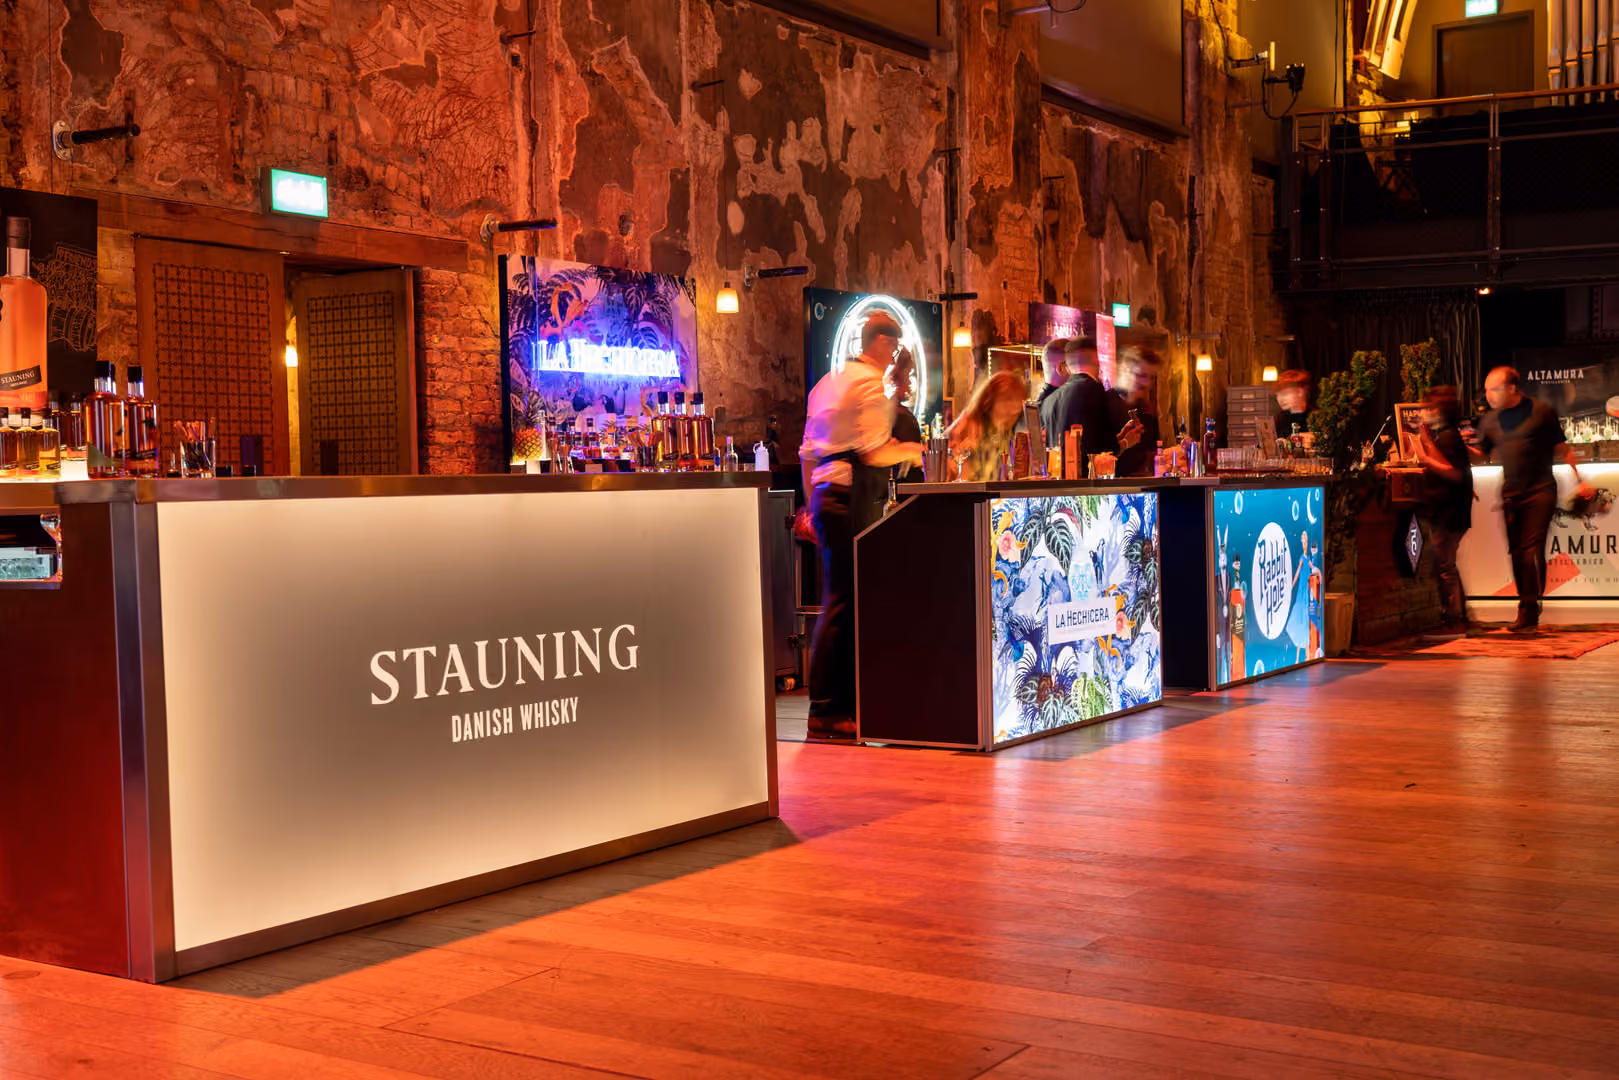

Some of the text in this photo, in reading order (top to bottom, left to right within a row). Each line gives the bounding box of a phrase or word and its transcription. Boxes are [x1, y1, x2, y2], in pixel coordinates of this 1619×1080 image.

[537, 340, 570, 370] LA
[1, 370, 35, 385] STAUNING
[1527, 369, 1584, 381] ALTAMURA
[1258, 537, 1287, 606] Rabbit
[1055, 613, 1066, 629] LA
[1066, 607, 1110, 627] HECHICERA
[1266, 577, 1285, 638] Hole
[369, 623, 640, 706] STAUNING
[451, 696, 579, 743] DANISH WHISKY
